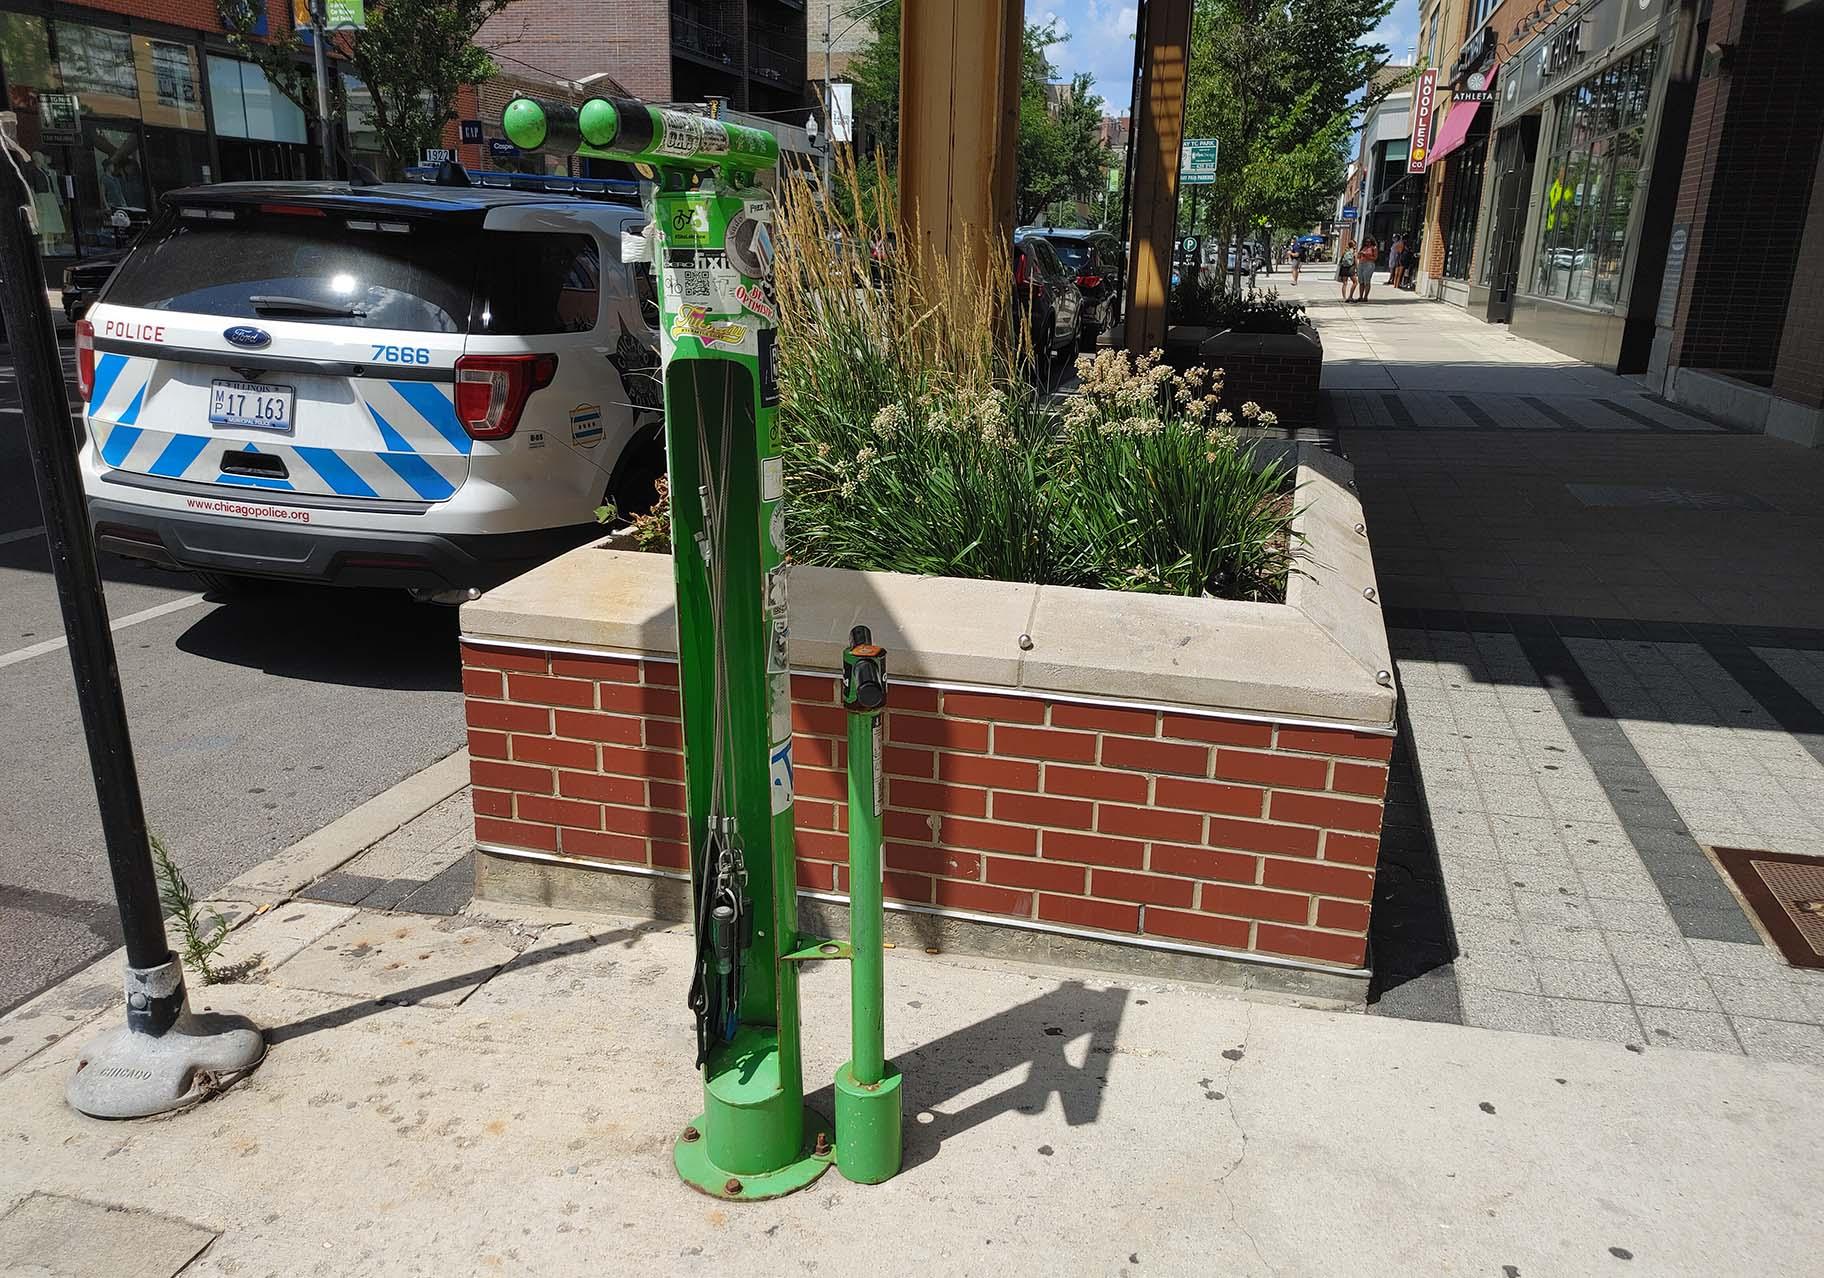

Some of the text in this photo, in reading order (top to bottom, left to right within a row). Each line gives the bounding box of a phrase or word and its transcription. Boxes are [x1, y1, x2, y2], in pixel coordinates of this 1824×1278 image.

[1453, 92, 1493, 100] ATHLETA
[1417, 75, 1433, 148] NOODLES
[465, 127, 479, 138] GAP
[427, 150, 449, 161] 1922
[750, 286, 763, 301] BE
[105, 320, 166, 343] POLICE
[371, 344, 430, 365] 7666
[233, 383, 271, 393] ILLINOIS
[226, 393, 246, 417] 17
[255, 396, 285, 421] 163
[186, 498, 311, 523] www.chicagopolice.org
[100, 1066, 152, 1081] CHICAGO
